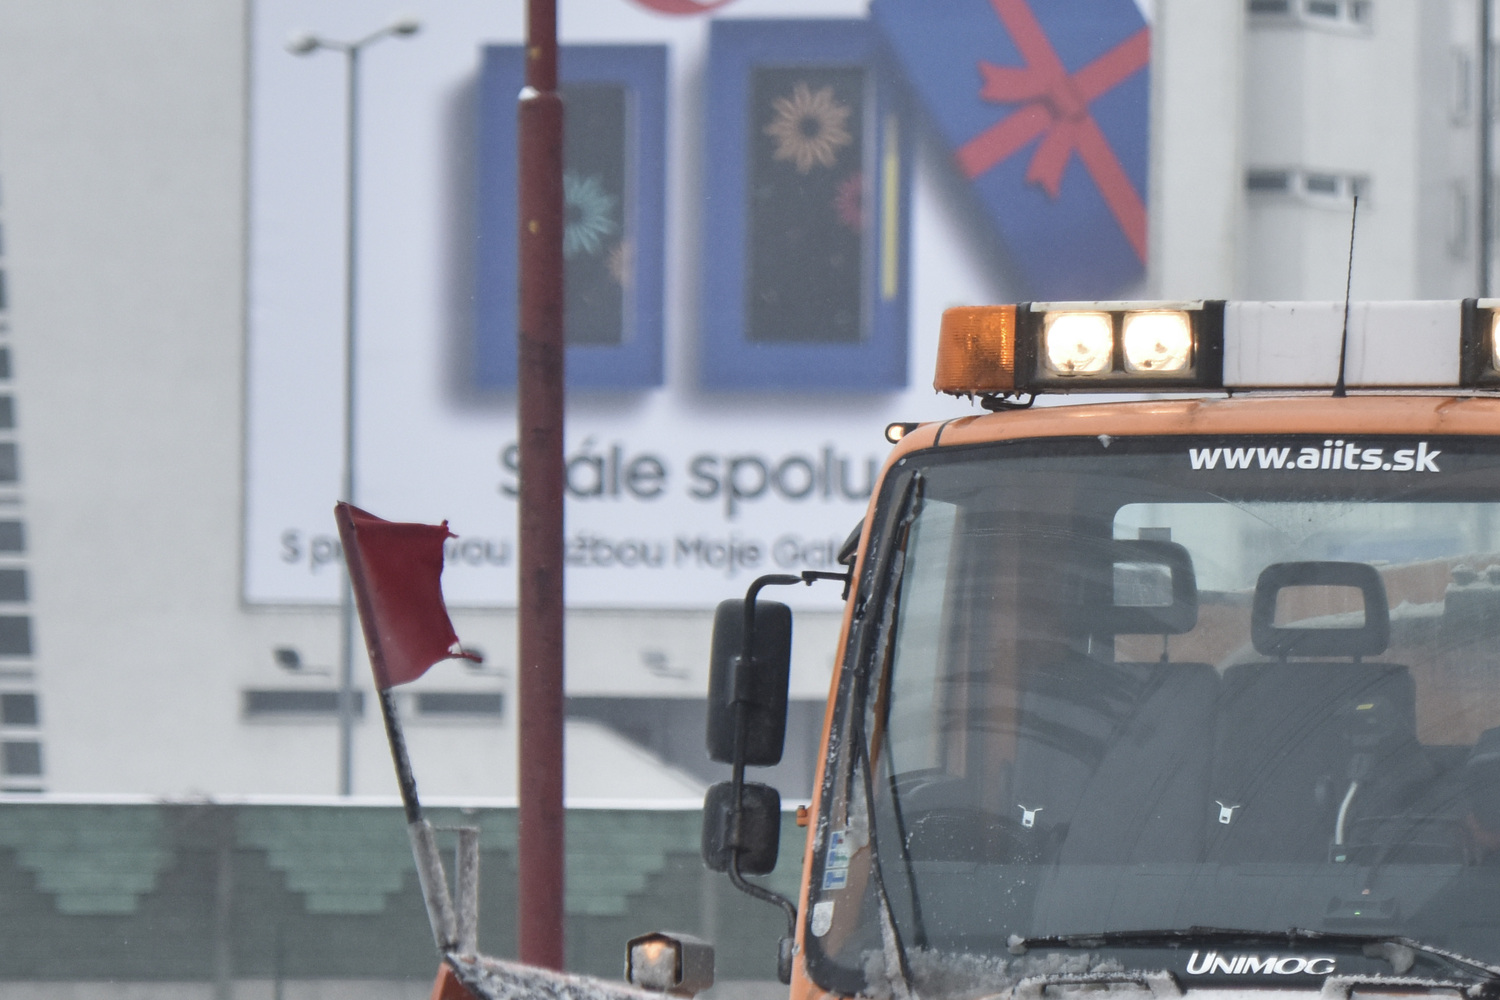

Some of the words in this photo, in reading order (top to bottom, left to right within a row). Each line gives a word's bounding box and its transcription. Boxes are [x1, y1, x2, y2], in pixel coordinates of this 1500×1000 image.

[1189, 439, 1442, 473] www.aiits.sk
[688, 443, 879, 520] spolu
[280, 528, 300, 565] S
[674, 530, 760, 577] Moje
[1186, 950, 1336, 975] UNIMOG
